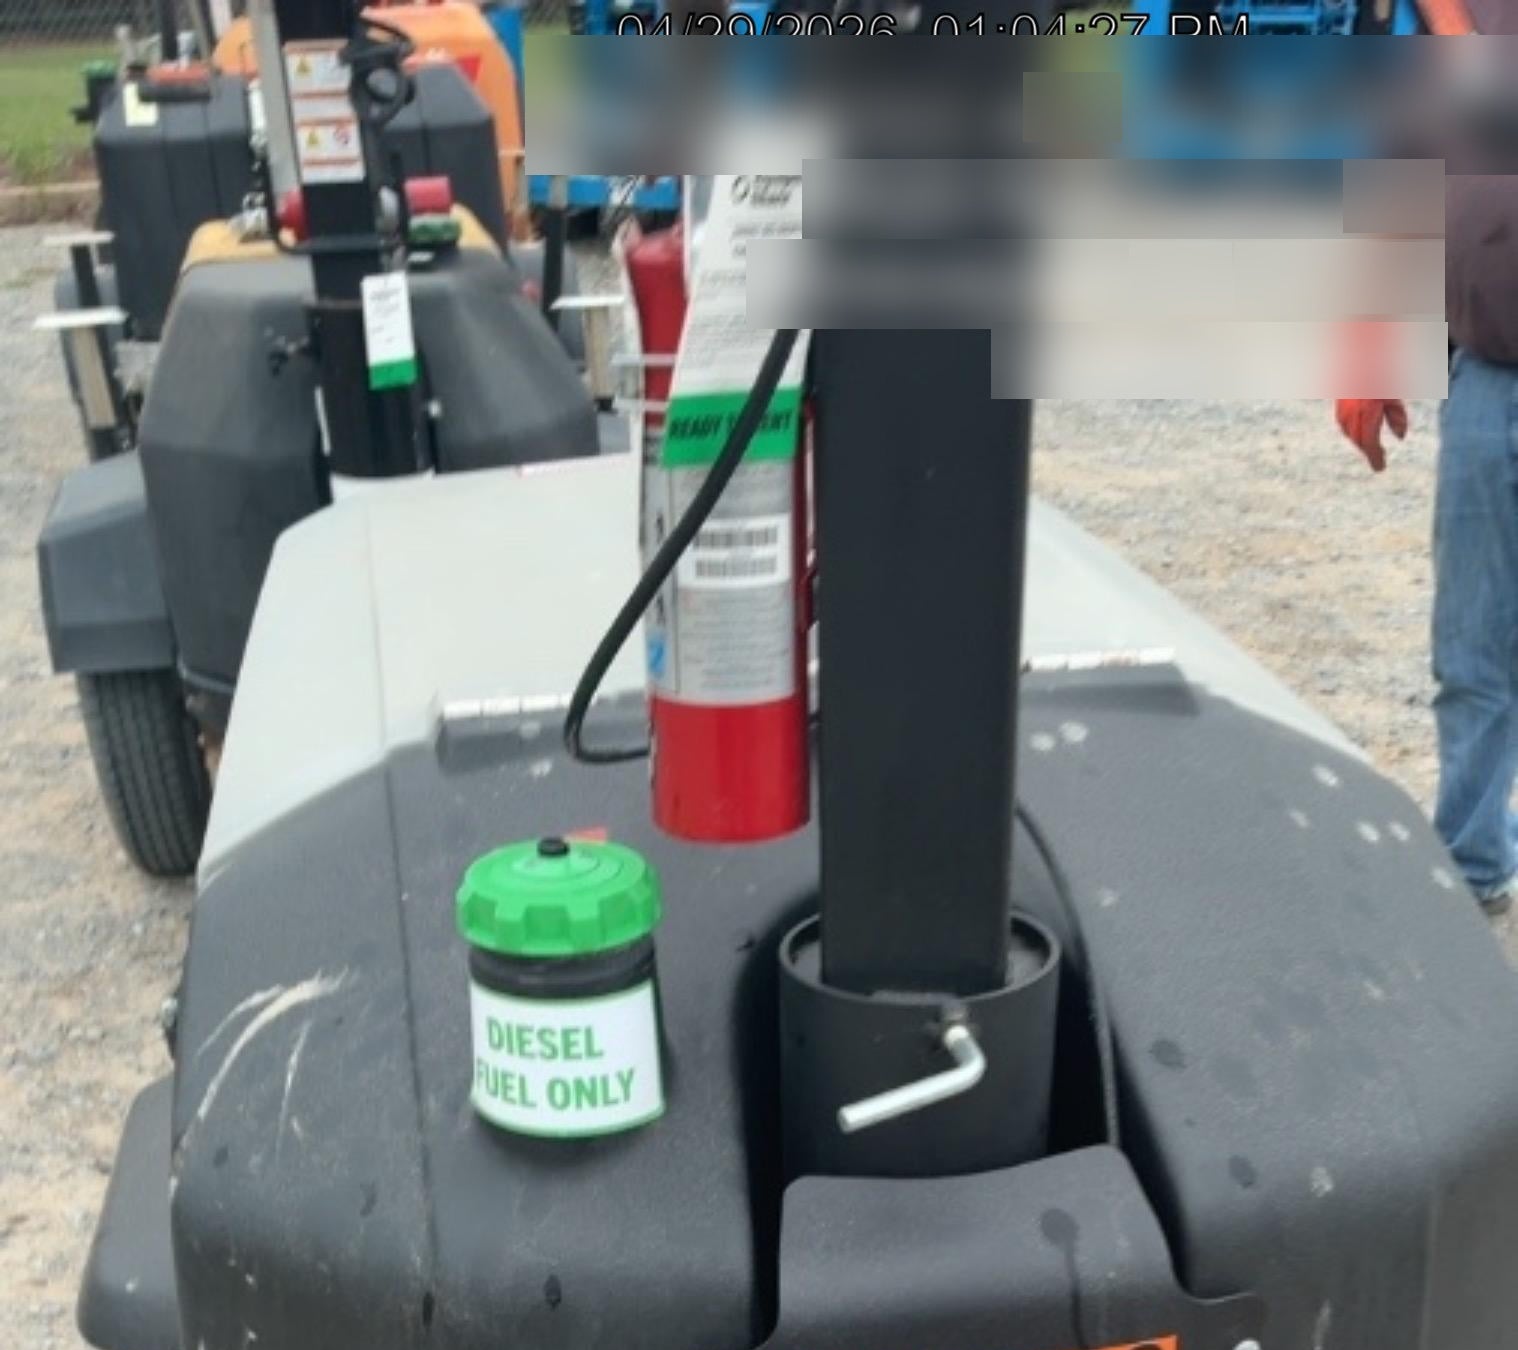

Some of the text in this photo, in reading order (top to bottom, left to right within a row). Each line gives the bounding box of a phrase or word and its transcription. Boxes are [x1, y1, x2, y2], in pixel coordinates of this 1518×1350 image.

[486, 1017, 604, 1060] DIESEL
[475, 1056, 635, 1111] FUEL ONLY
